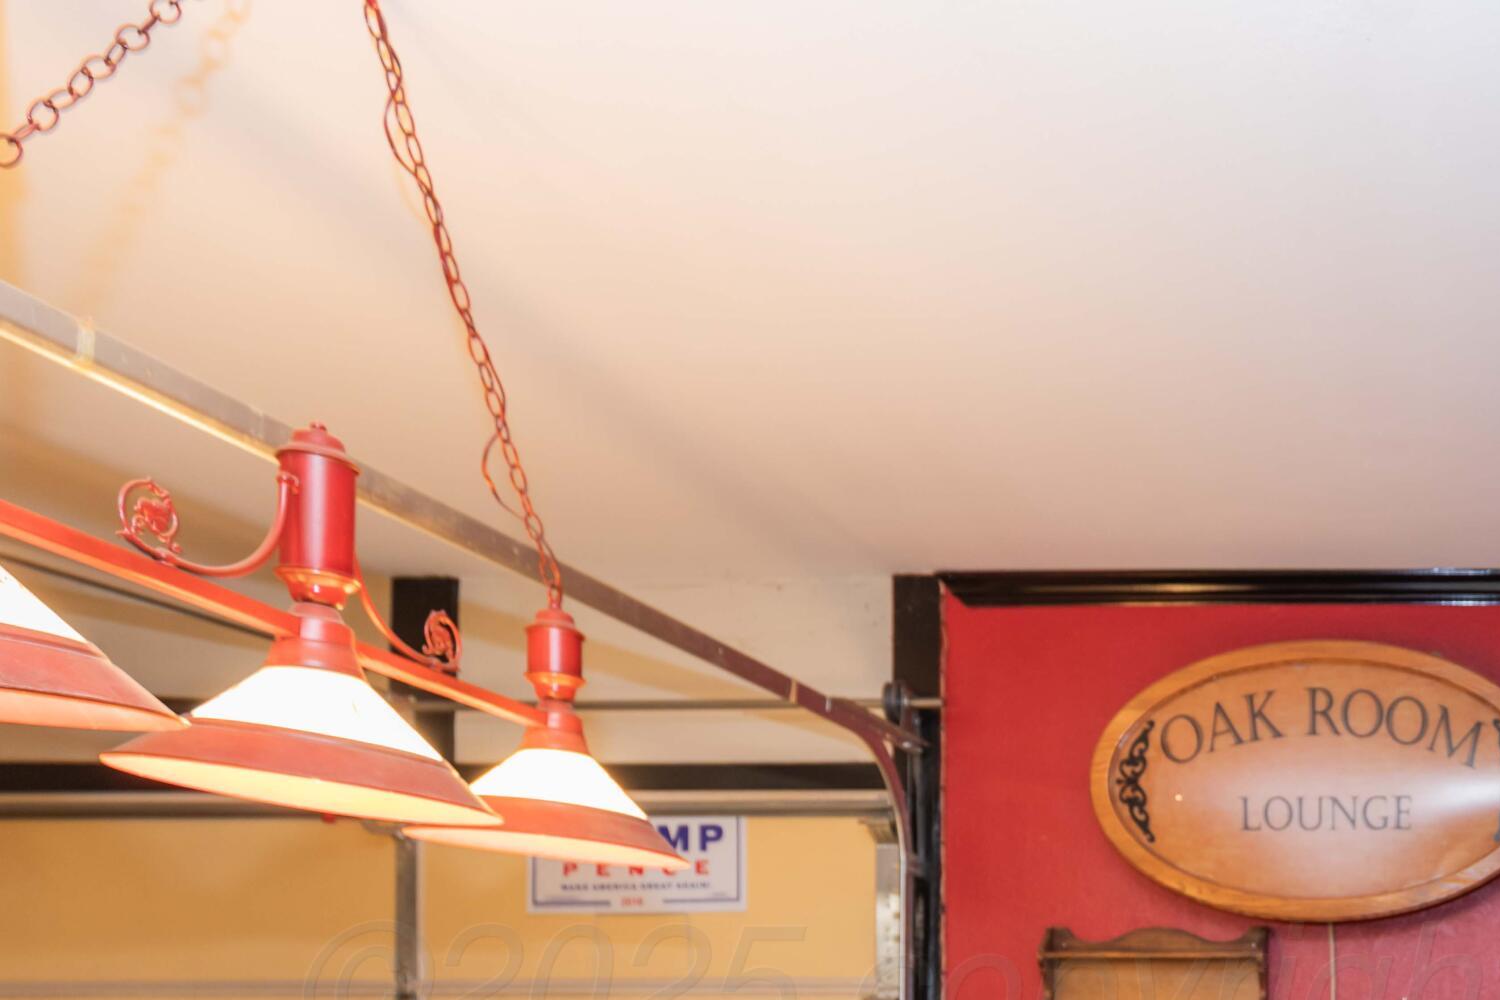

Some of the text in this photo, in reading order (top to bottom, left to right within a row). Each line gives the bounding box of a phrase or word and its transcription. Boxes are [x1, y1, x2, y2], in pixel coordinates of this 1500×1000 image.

[1159, 686, 1485, 770] OAK ROOM
[1240, 795, 1413, 832] LOUNGE
